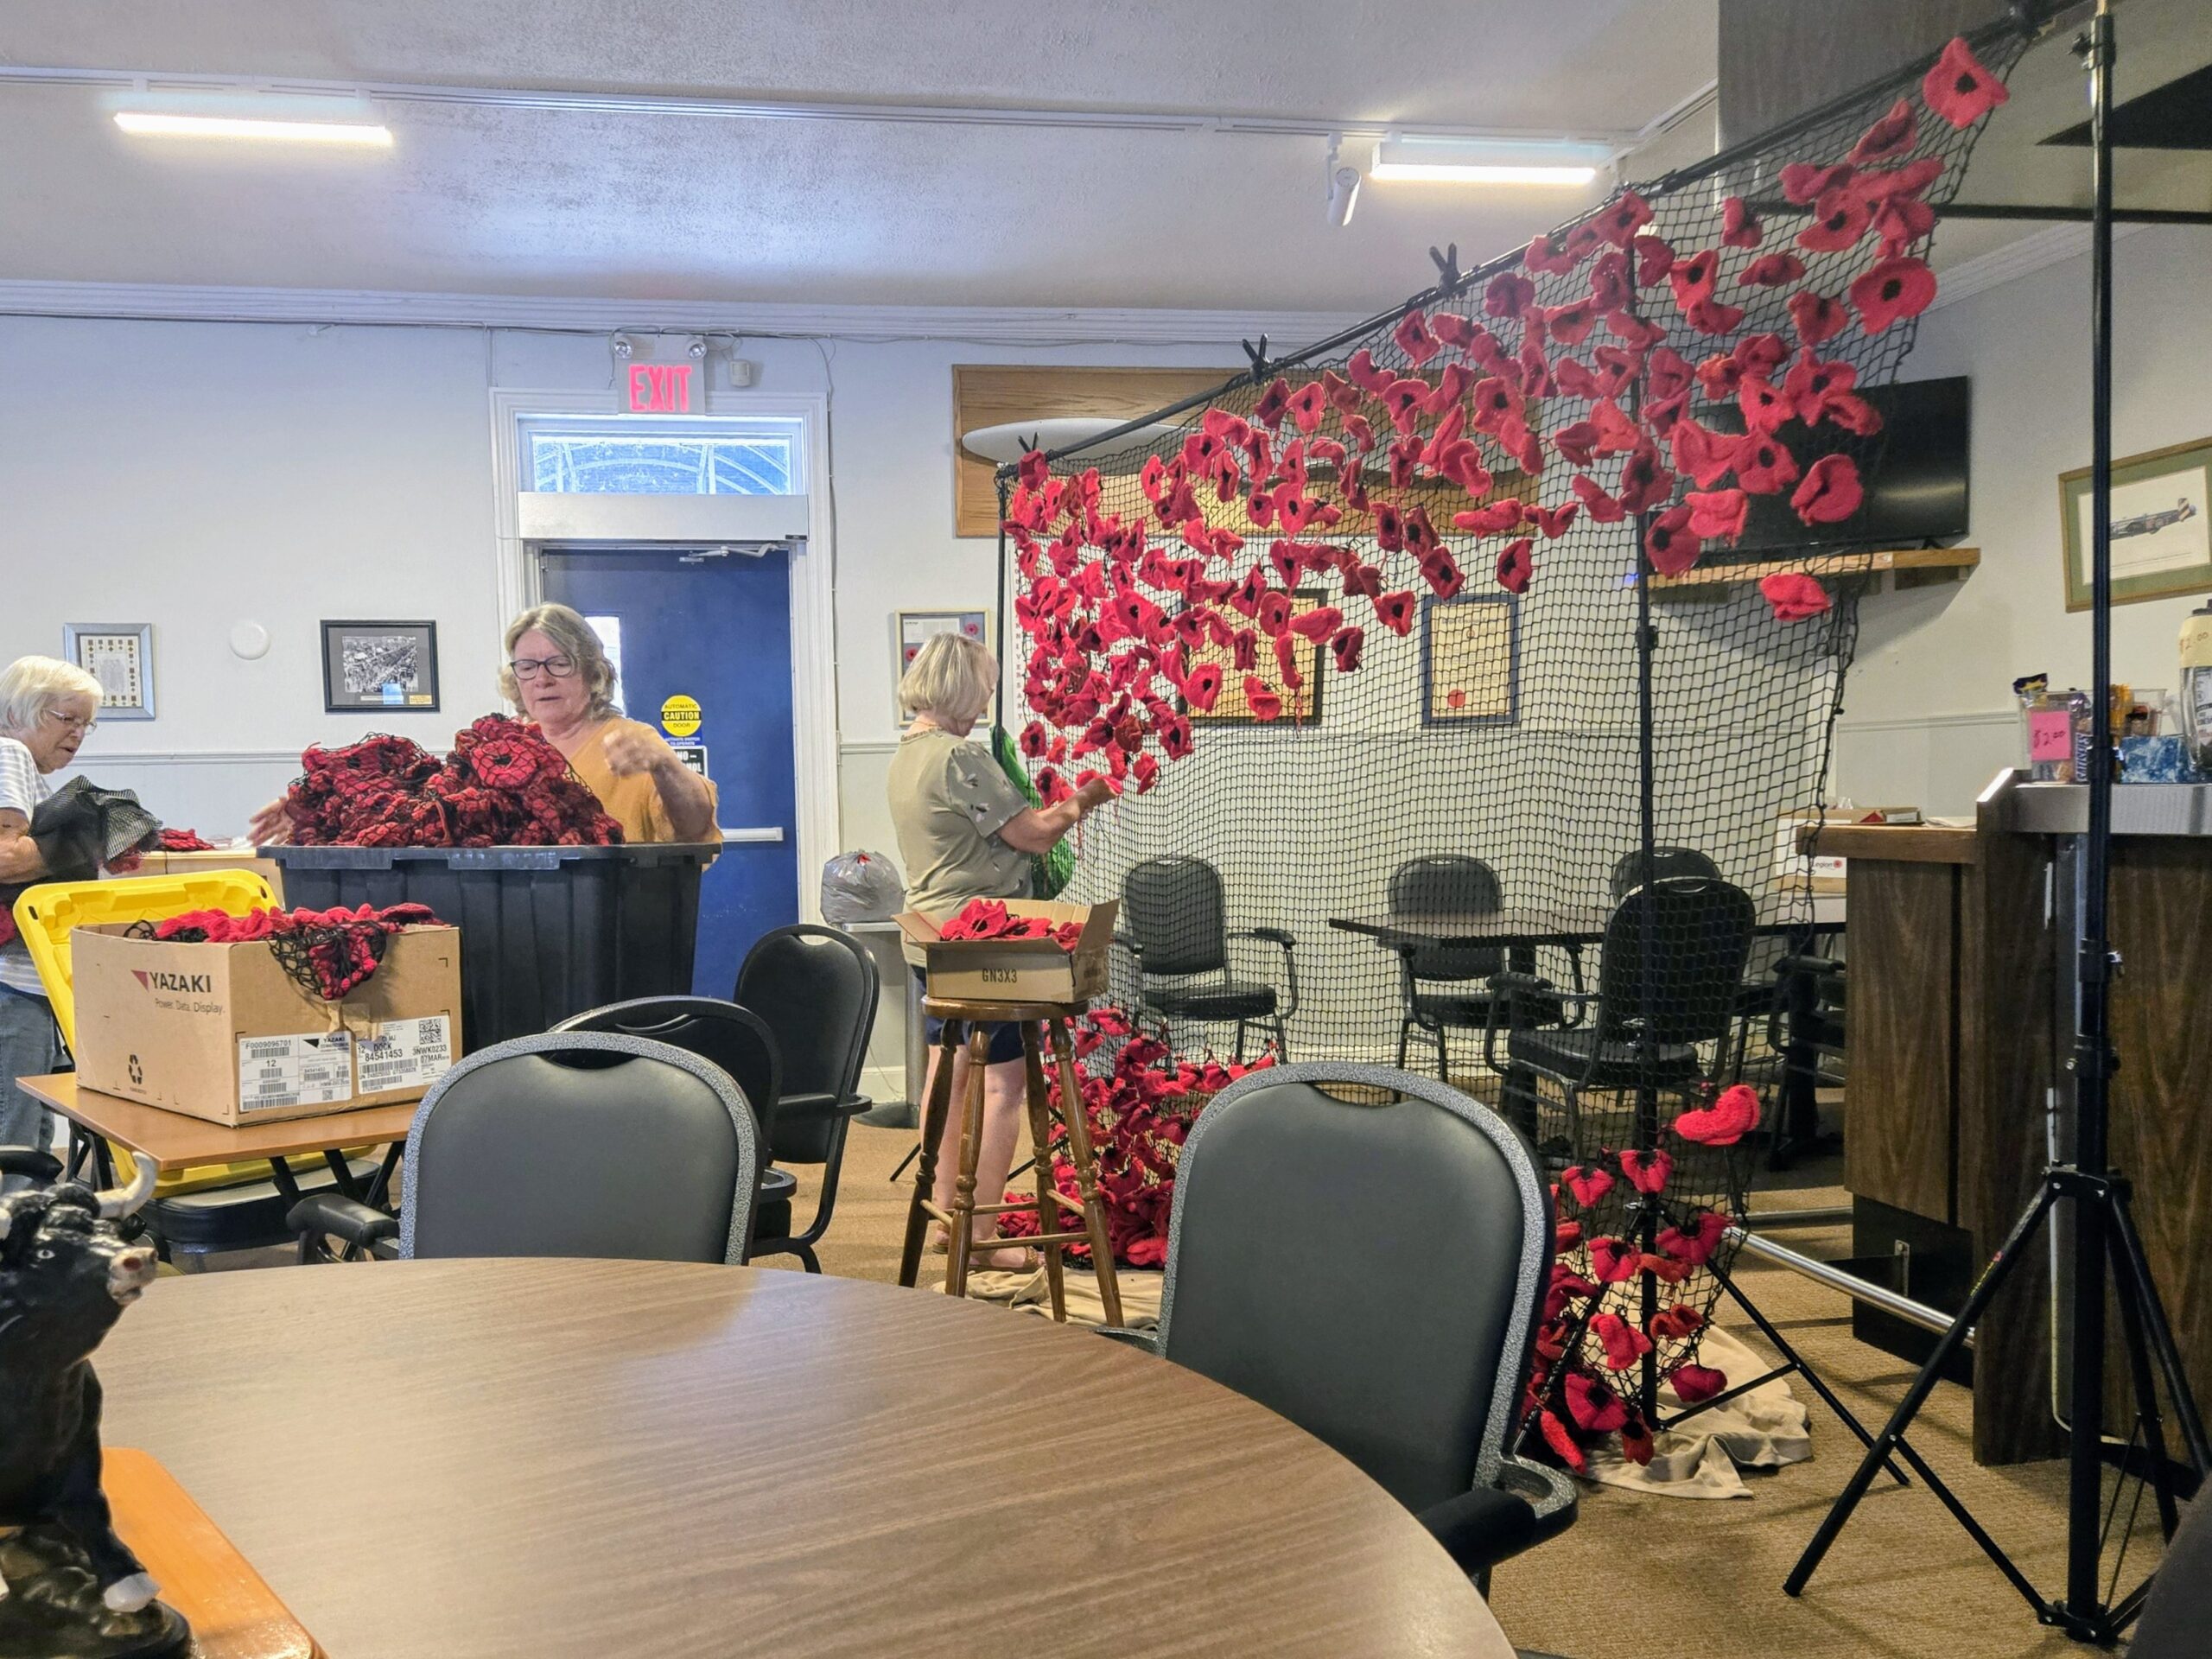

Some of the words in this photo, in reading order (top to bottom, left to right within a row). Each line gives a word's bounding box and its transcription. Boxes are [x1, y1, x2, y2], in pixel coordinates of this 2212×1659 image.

[629, 364, 692, 413] EXIT
[677, 751, 689, 760] NO
[149, 971, 212, 993] YAZAKI
[982, 968, 1017, 983] GN3X3
[245, 1039, 291, 1049] F0009096701
[373, 1042, 392, 1052] DOCK
[365, 1048, 403, 1062] 84541453
